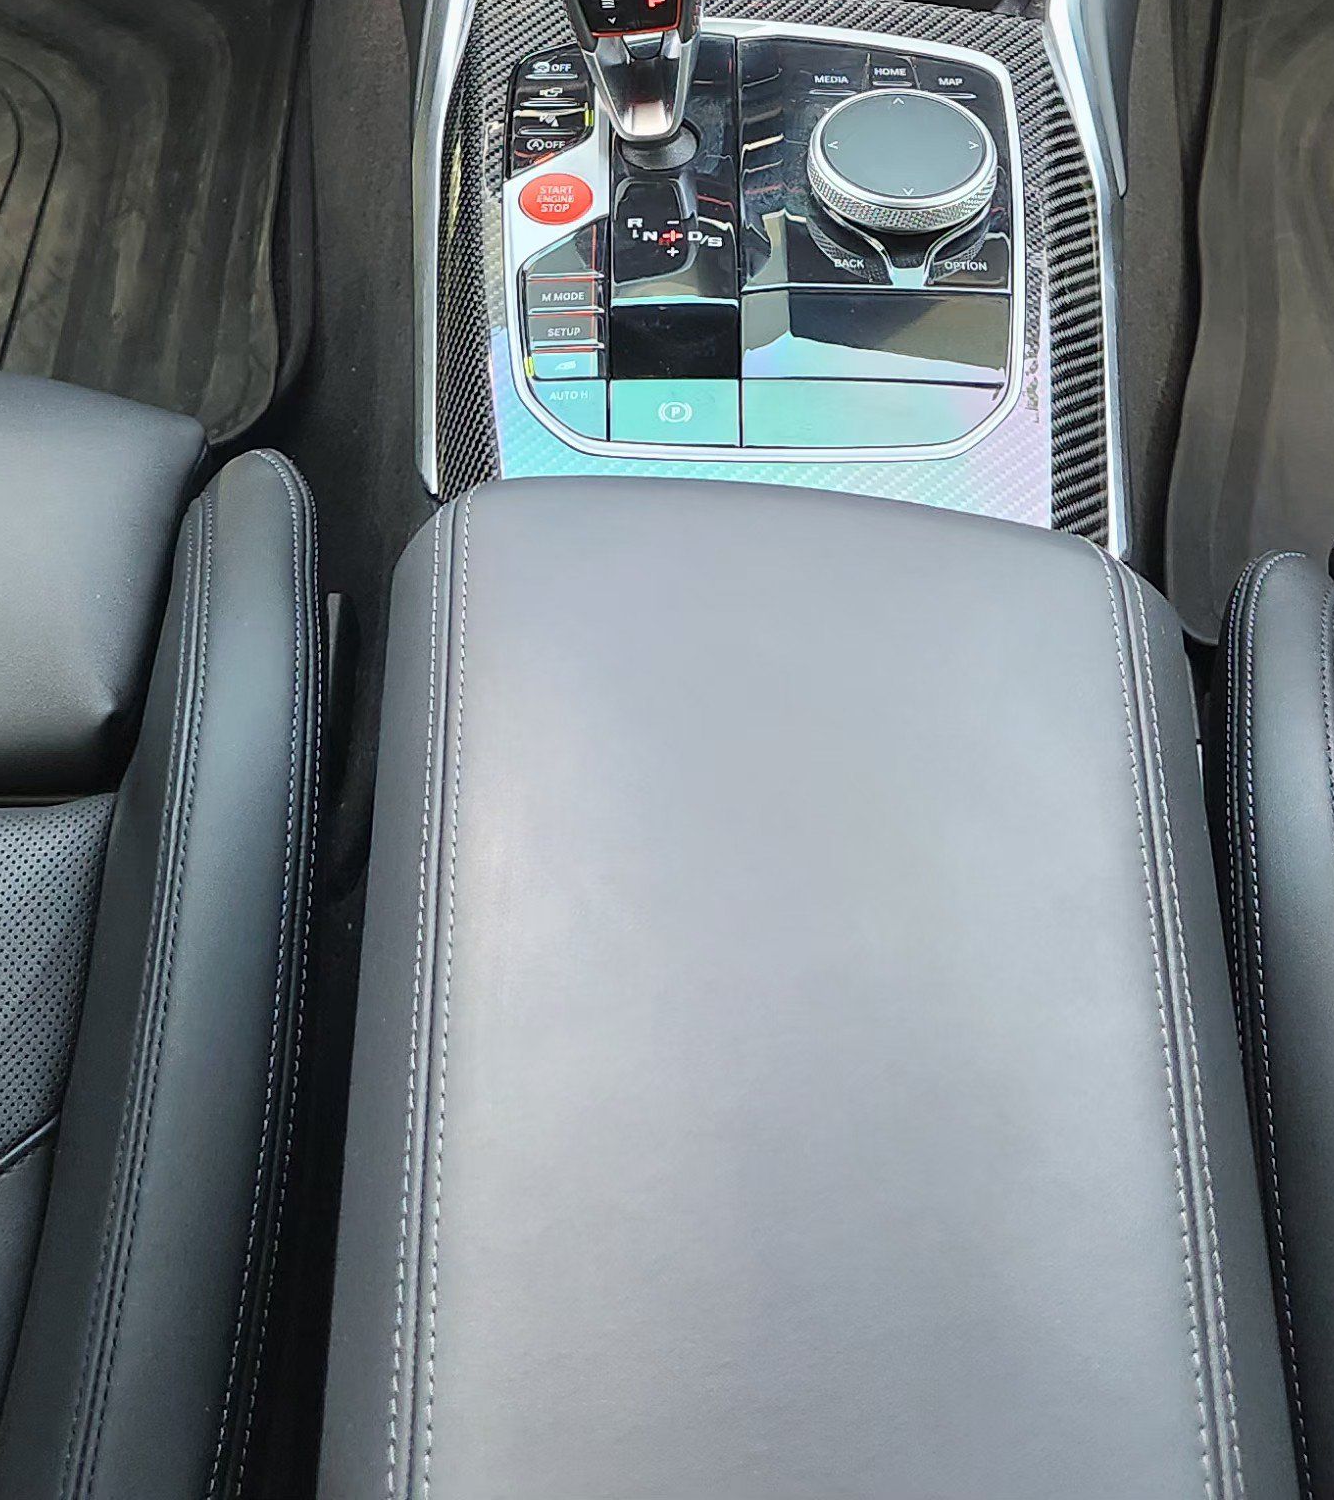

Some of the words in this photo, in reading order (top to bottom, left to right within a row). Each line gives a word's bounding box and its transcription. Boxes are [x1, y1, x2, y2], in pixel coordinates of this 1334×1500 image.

[551, 63, 572, 73] OFF
[874, 67, 907, 77] HOME
[814, 74, 849, 85] MEDIA
[938, 77, 964, 87] MAP
[544, 140, 566, 150] OFF
[540, 185, 574, 195] START
[536, 194, 575, 203] ENGINE
[540, 203, 570, 213] STOP
[627, 218, 643, 228] R
[642, 231, 658, 241] N
[687, 231, 723, 247] D/S
[834, 258, 865, 269] BACK
[944, 260, 988, 271] OPTION
[541, 293, 552, 302] M
[554, 291, 585, 301] MODE
[547, 327, 581, 337] SETUP
[549, 391, 578, 400] AUTO
